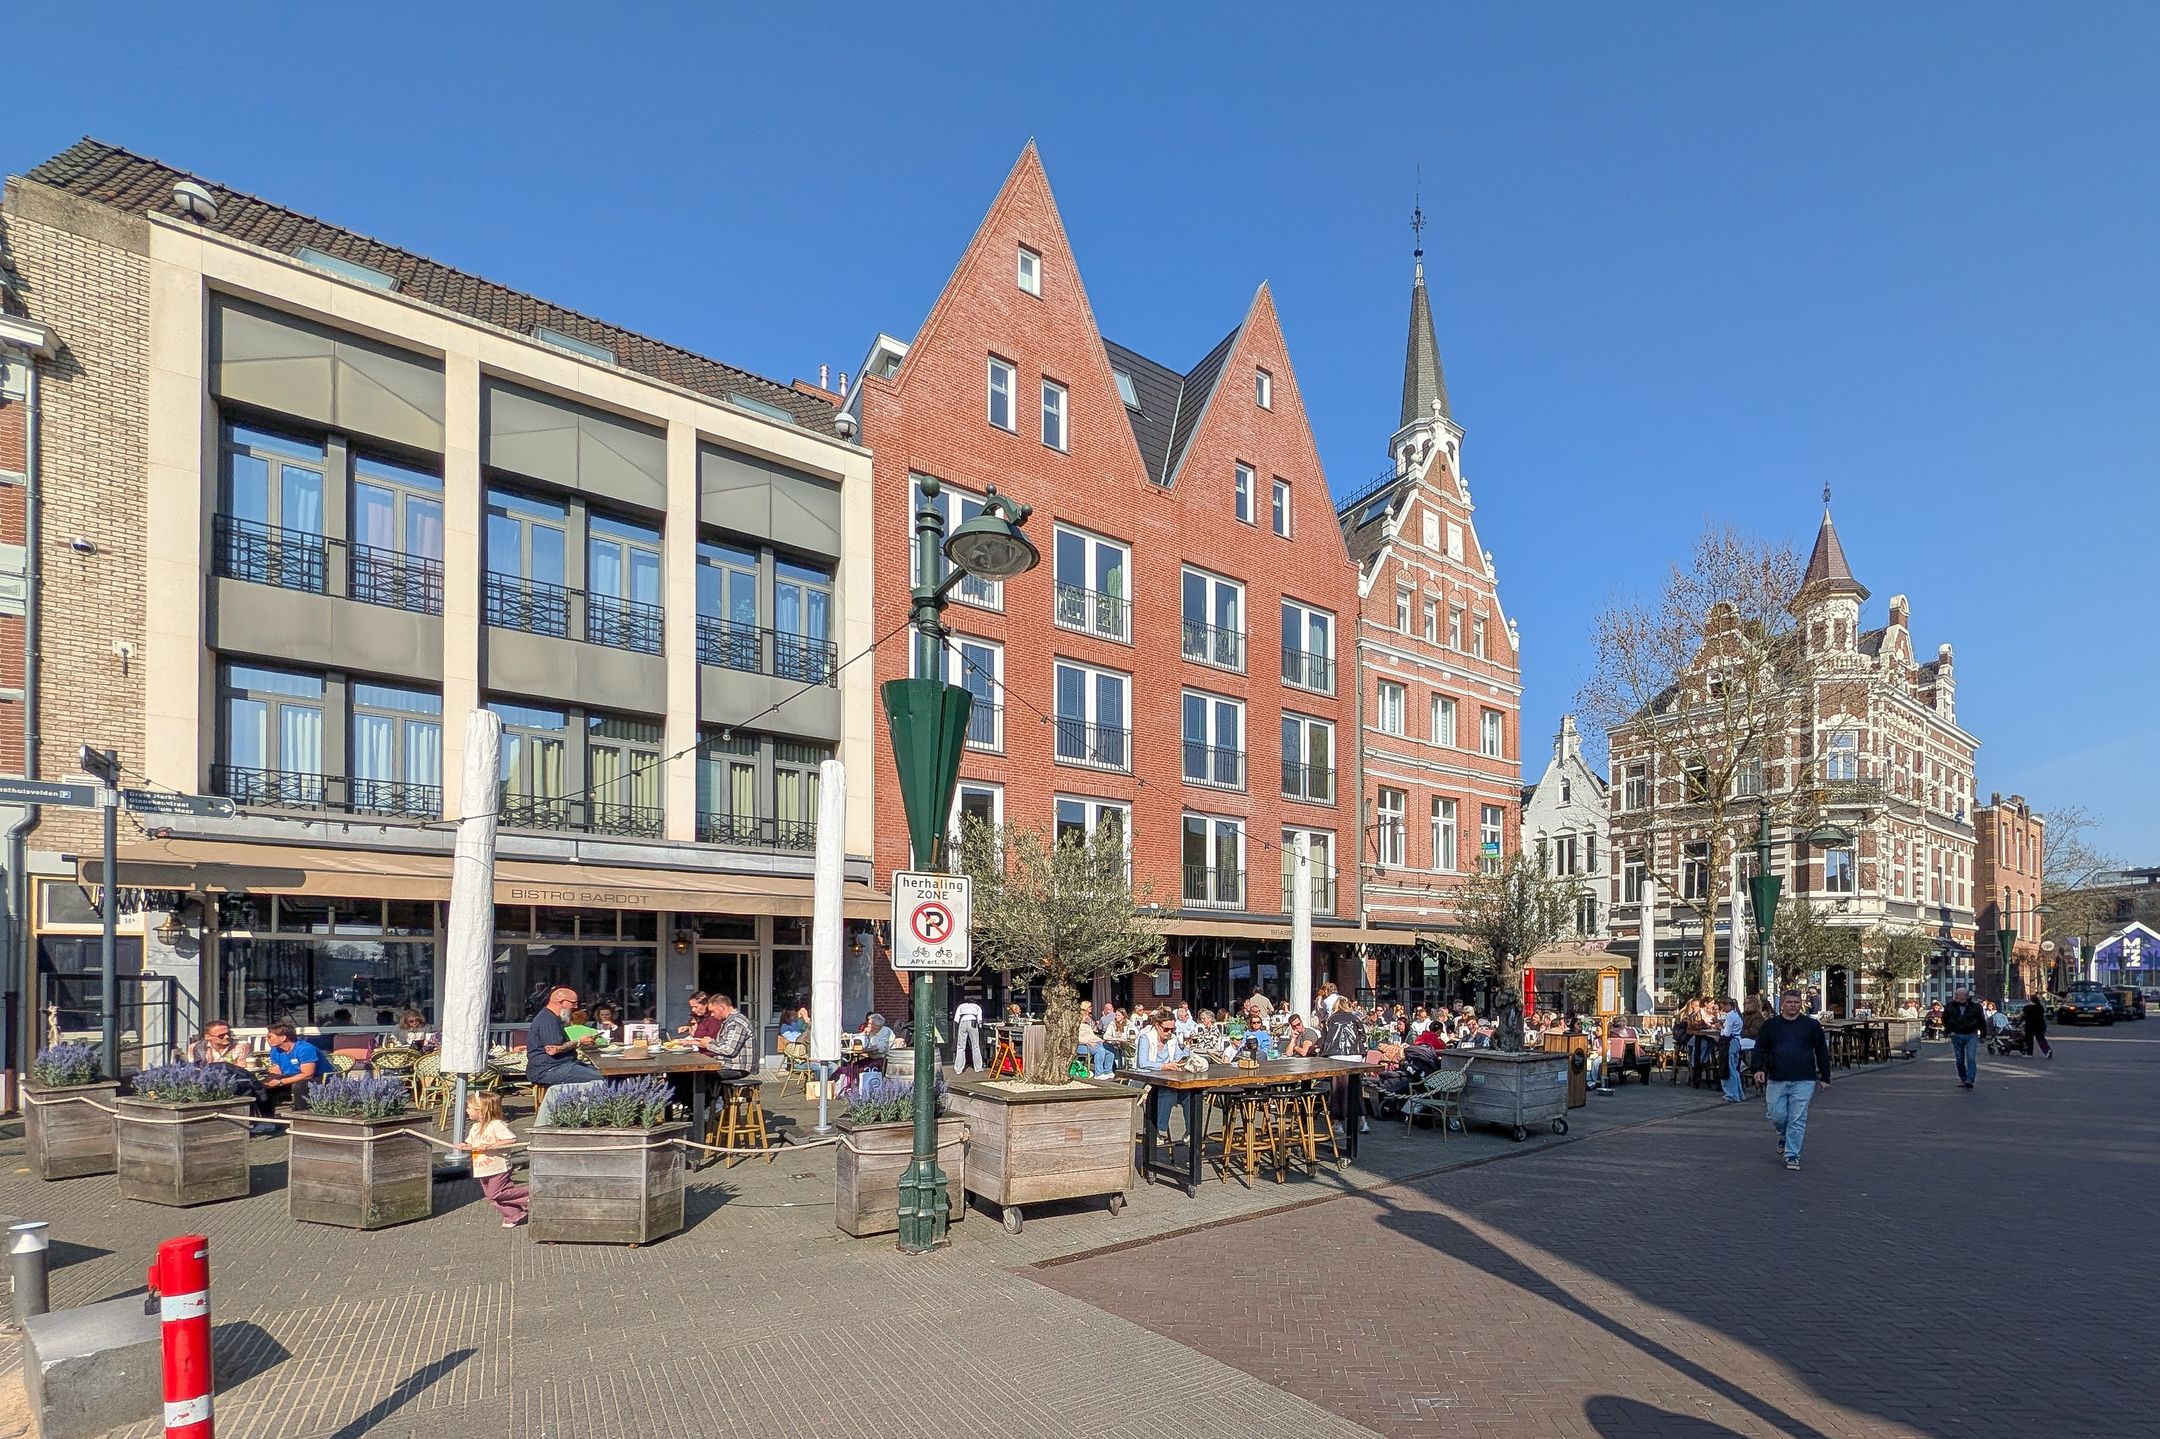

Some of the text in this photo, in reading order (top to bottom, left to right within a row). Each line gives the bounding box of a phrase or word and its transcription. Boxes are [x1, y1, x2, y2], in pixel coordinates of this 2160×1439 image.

[903, 877, 963, 892] herhaling
[511, 889, 649, 904] BISTRO BARDOT
[917, 890, 949, 900] ZONE
[1270, 928, 1332, 939] BRASS ARDOT
